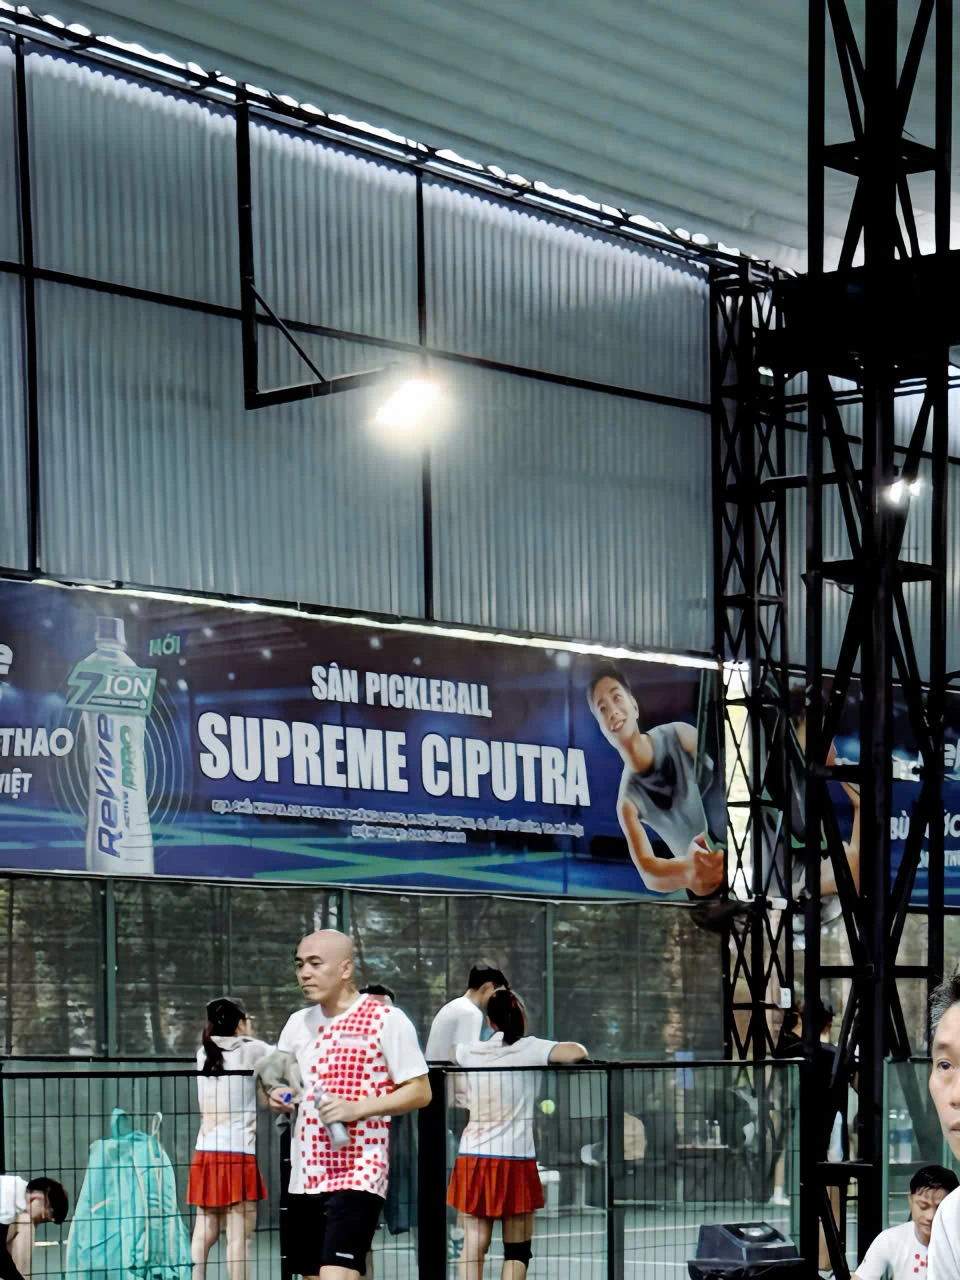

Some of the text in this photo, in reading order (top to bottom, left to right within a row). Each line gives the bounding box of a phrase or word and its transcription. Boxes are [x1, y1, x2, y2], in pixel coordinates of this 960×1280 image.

[104, 675, 151, 697] ION
[311, 661, 493, 719] SÂN PICKLEBALL
[0, 727, 75, 757] THAO
[197, 712, 591, 807] SUPREME CIPUTRA
